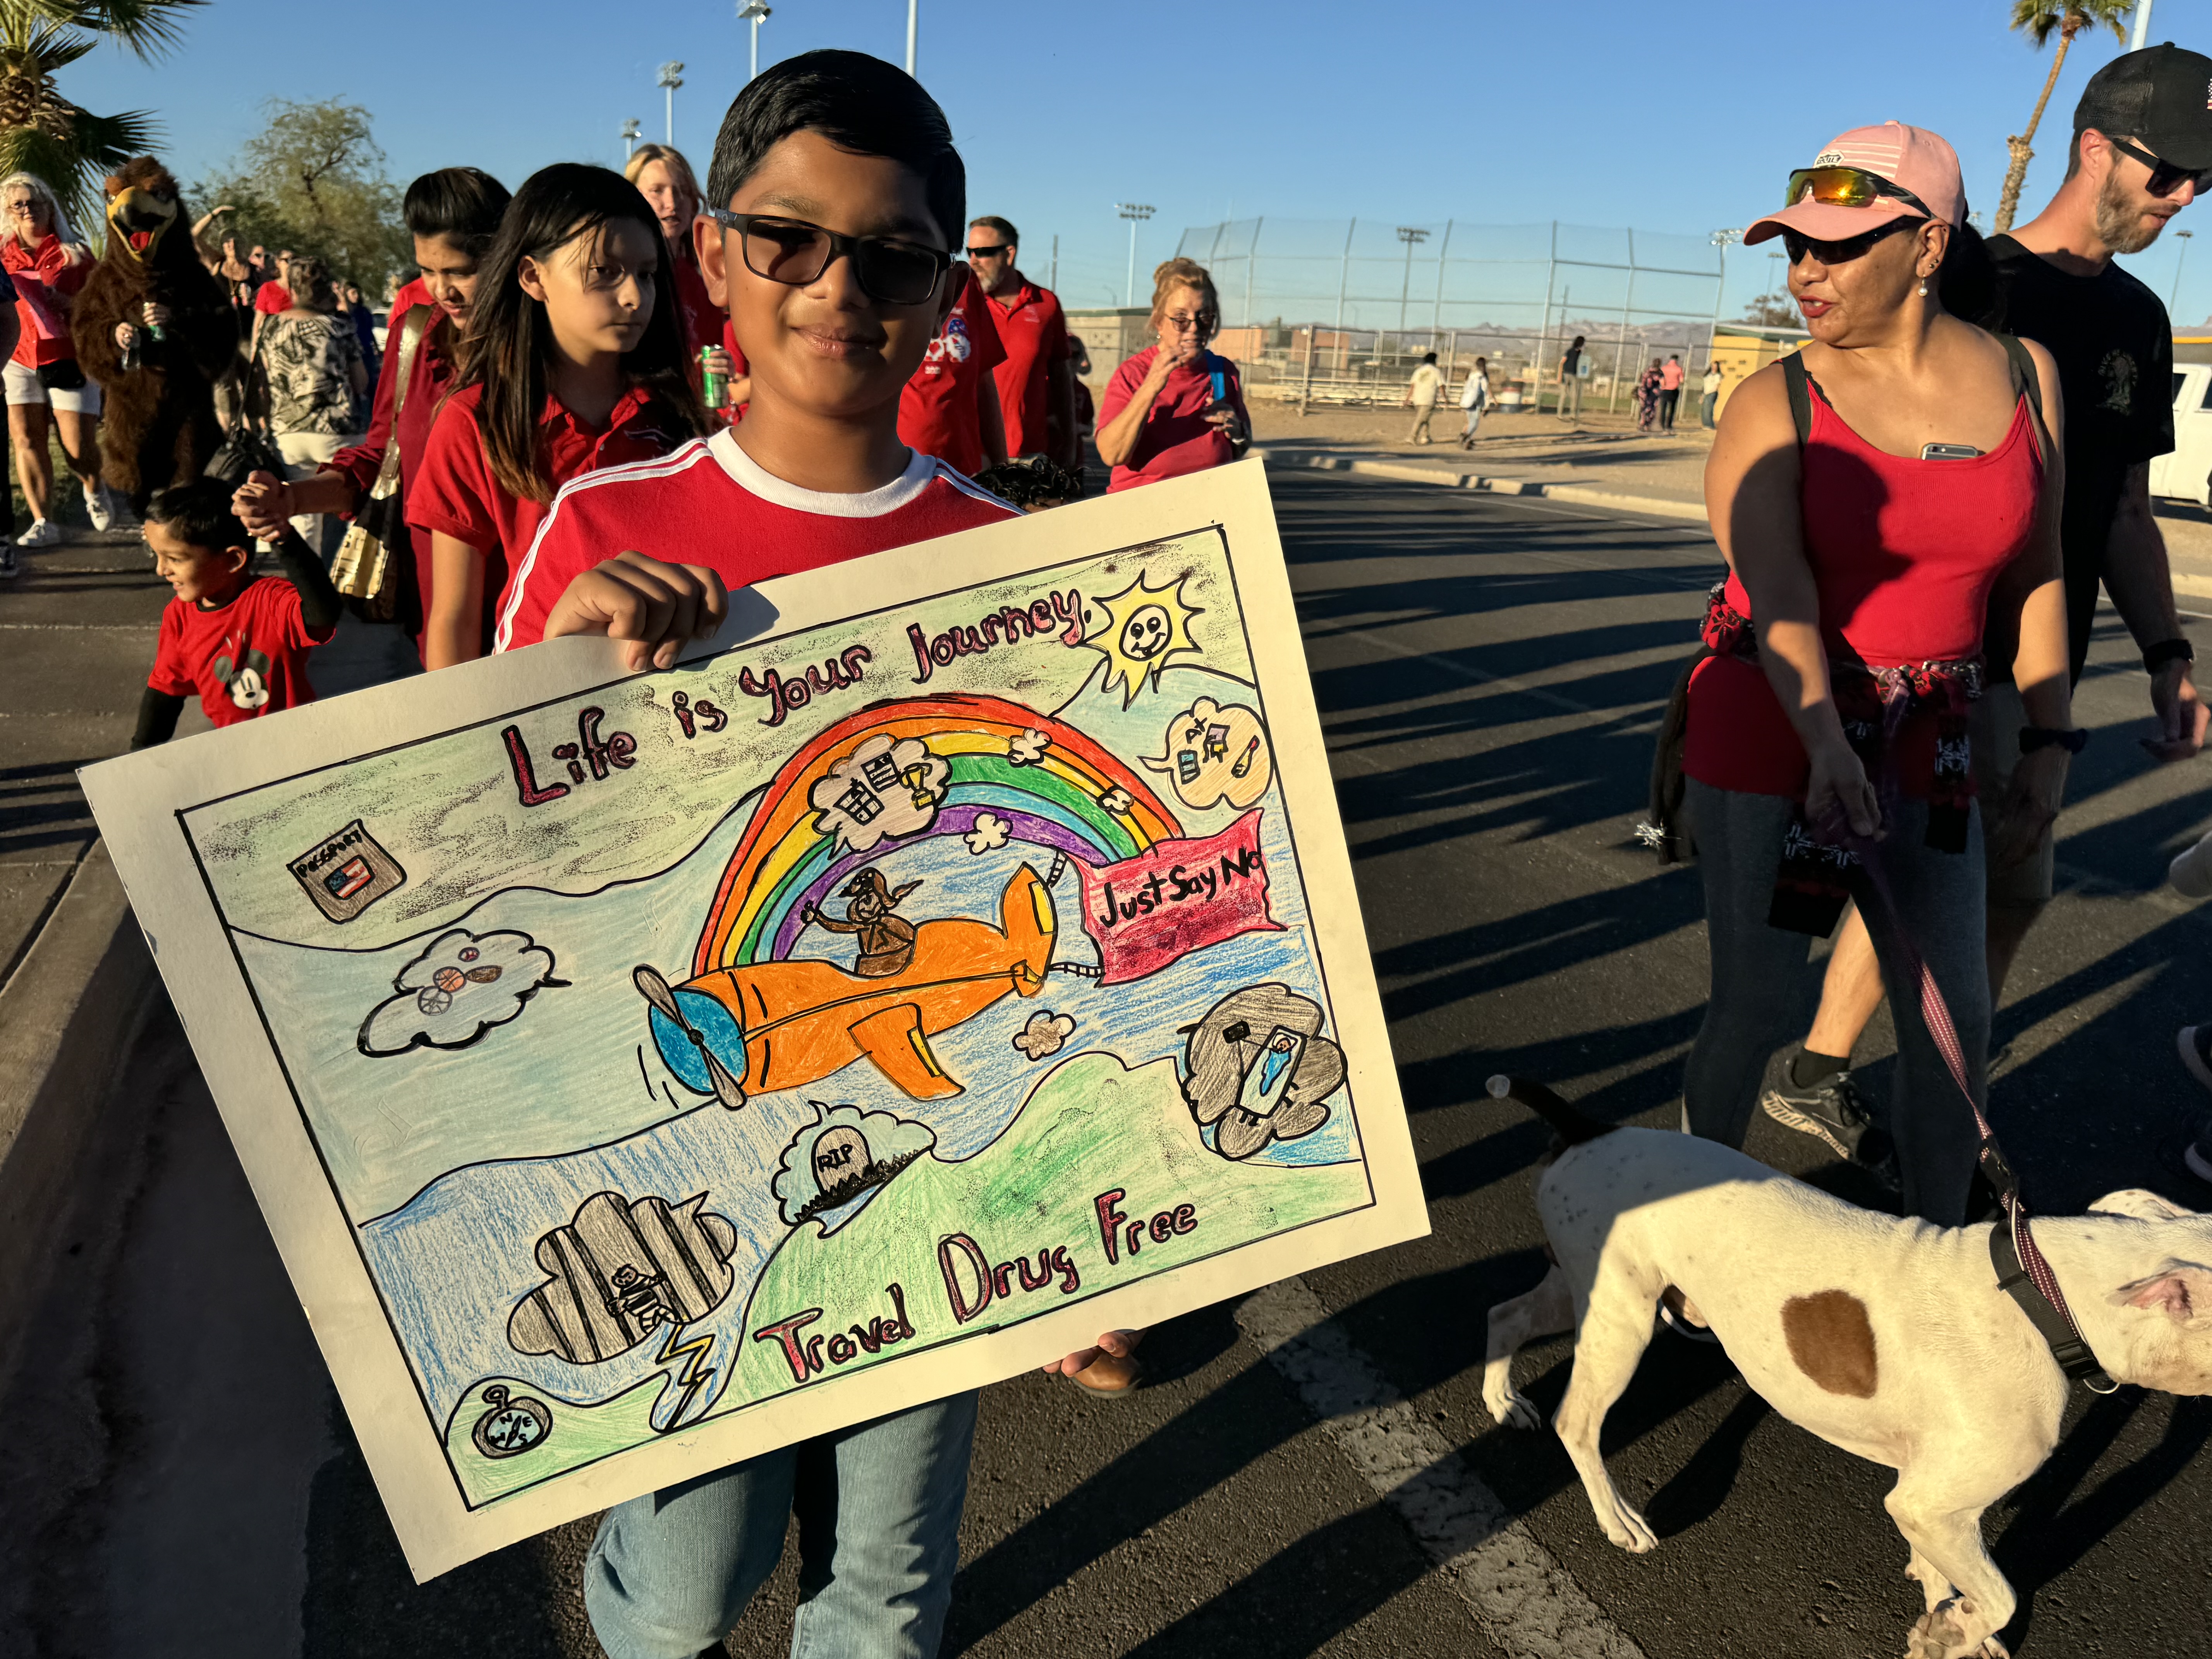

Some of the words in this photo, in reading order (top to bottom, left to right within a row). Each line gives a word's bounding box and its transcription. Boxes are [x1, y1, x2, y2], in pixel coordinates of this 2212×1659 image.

[501, 706, 637, 807] Life
[672, 691, 728, 739] is
[738, 645, 872, 727] Your
[1100, 872, 1167, 928] Just
[1169, 865, 1216, 901] Say
[1221, 847, 1262, 886] No
[817, 1144, 853, 1173] RIP
[752, 1283, 916, 1383] Travel
[938, 1231, 1080, 1325] Drug
[1093, 1187, 1198, 1266] Free
[500, 1413, 513, 1425] N
[522, 1417, 532, 1428] E
[518, 1433, 528, 1446] S
